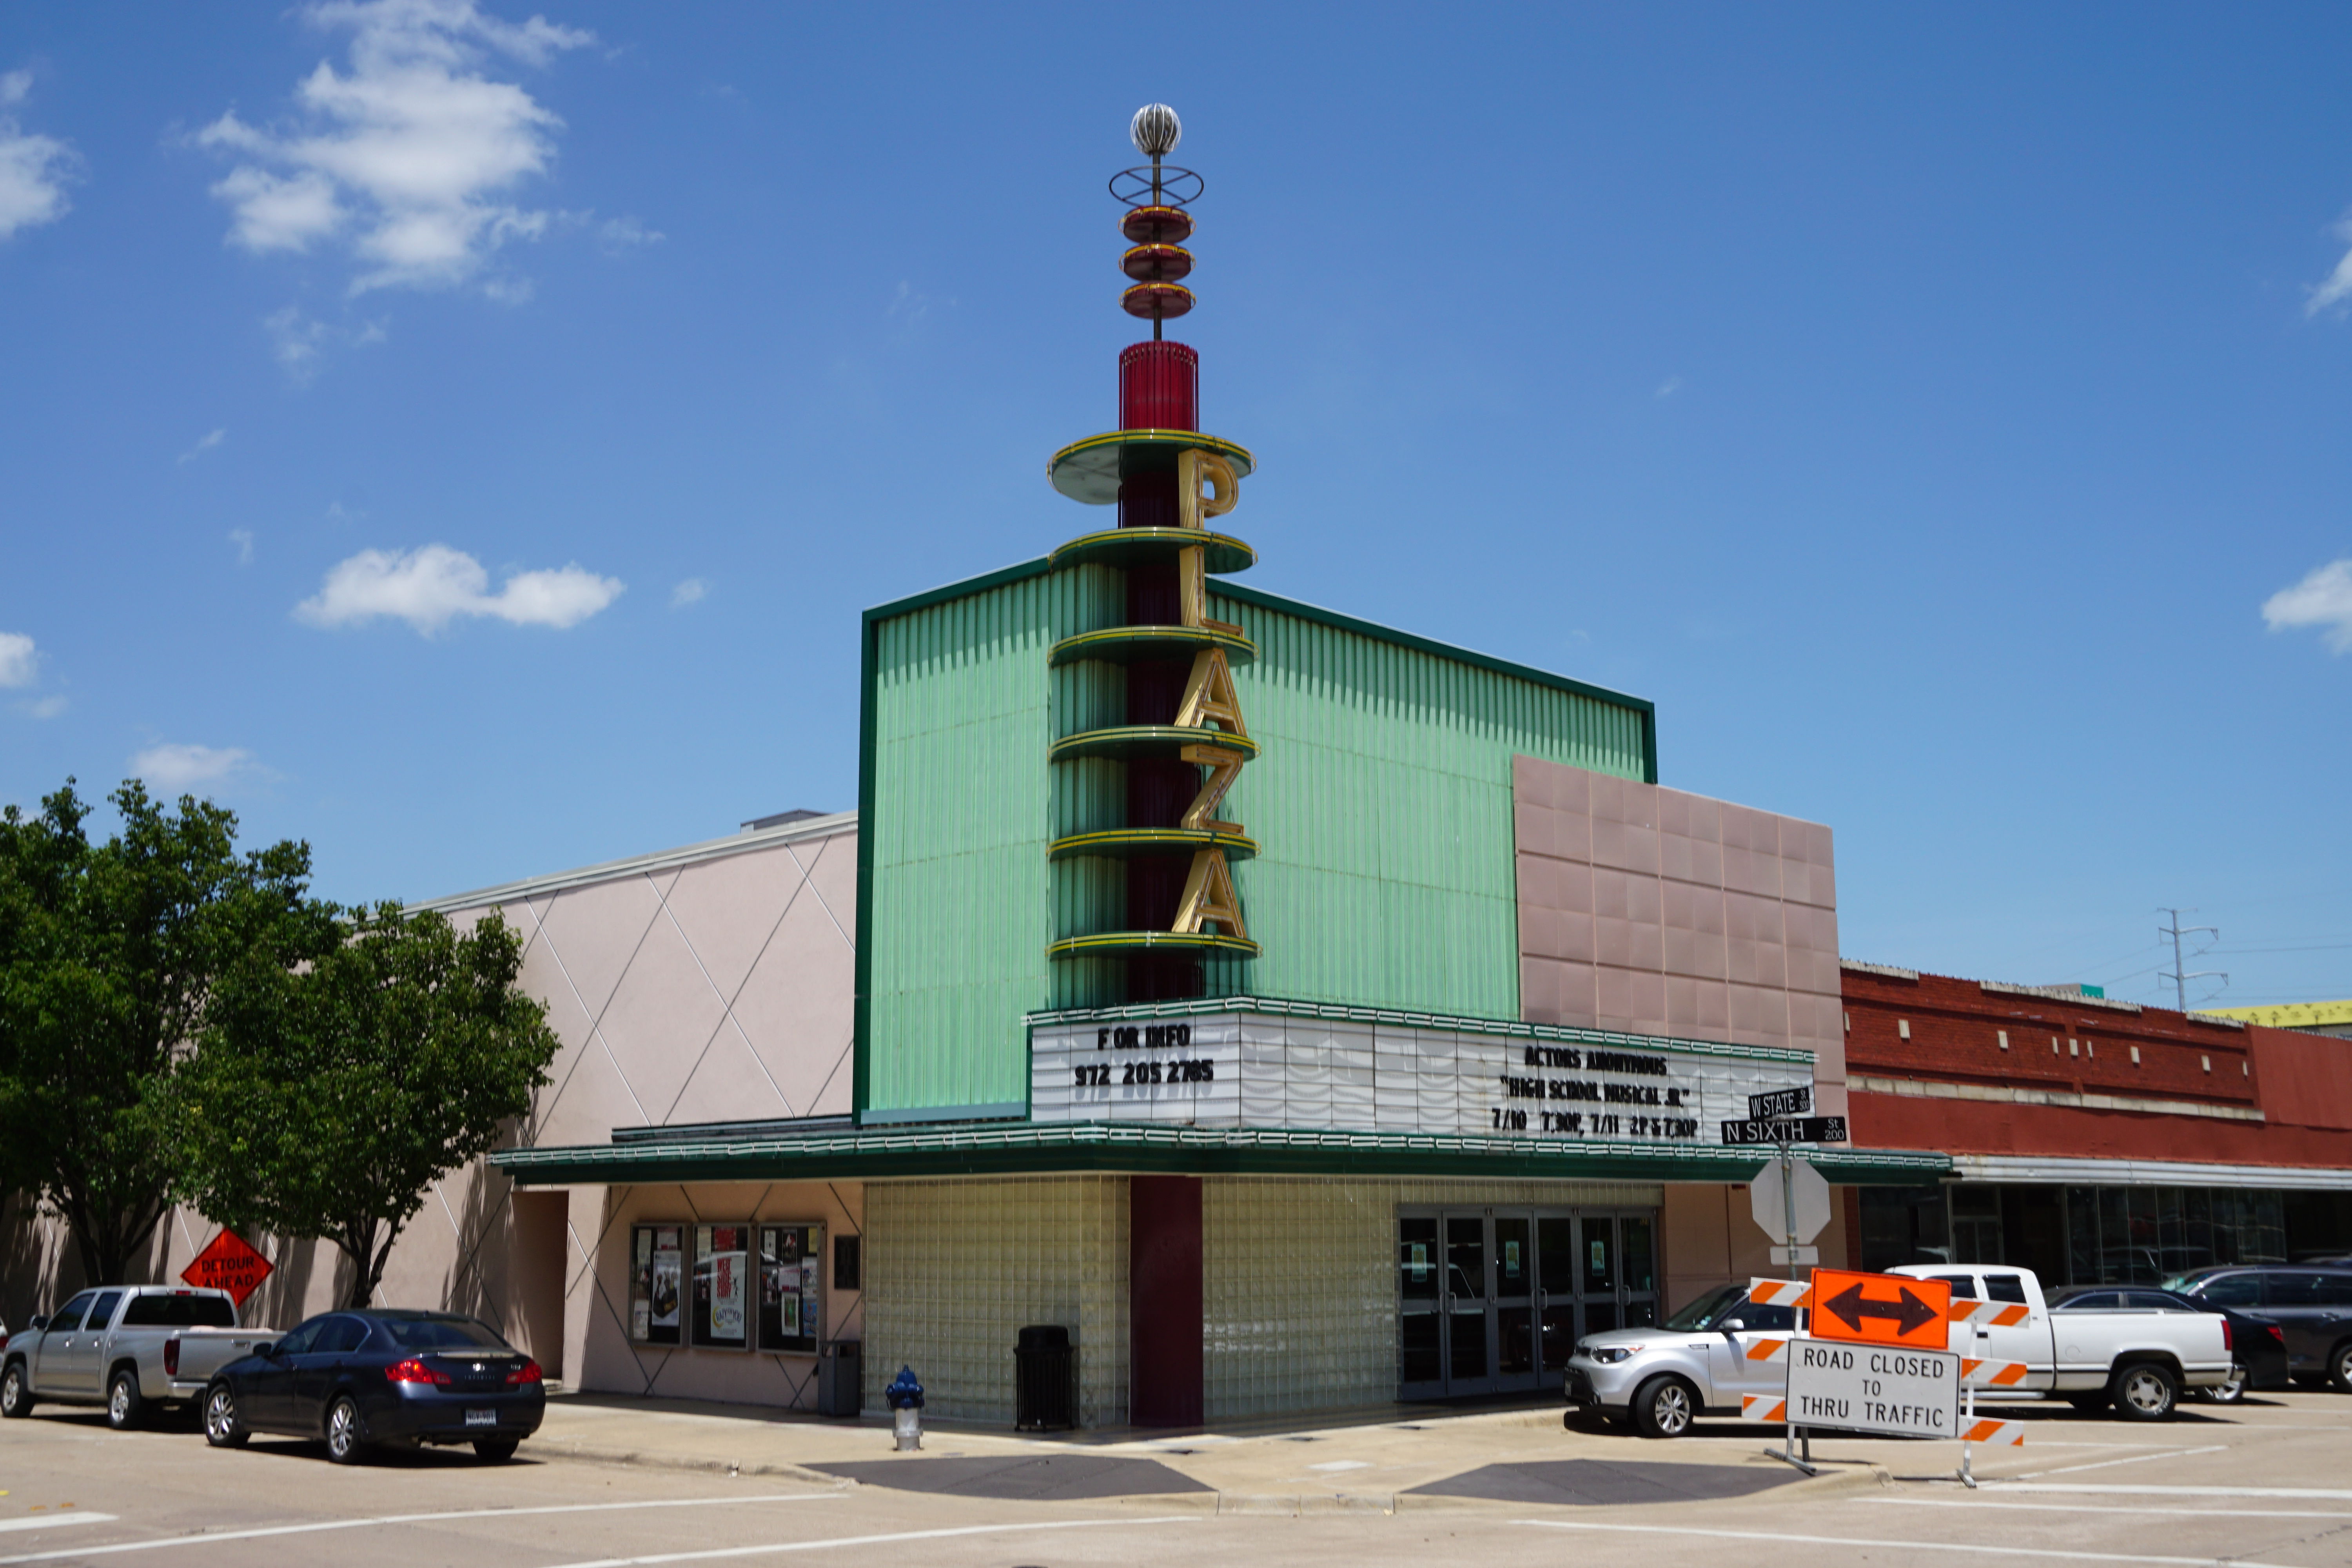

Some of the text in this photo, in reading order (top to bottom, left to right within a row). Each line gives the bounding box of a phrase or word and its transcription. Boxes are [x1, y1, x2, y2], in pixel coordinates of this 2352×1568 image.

[1172, 448, 1247, 939] PLAZA
[1098, 1024, 1191, 1050] FOR INFO
[1075, 1058, 1214, 1086] 972 205 2785
[1525, 1045, 1667, 1075] ACTORS ANONYMOUS
[1549, 1080, 1602, 1101] SCHOOL
[1604, 1083, 1662, 1105] MUSICAL
[1751, 1089, 1806, 1118] W STATE St
[1492, 1107, 1527, 1131] 7/10
[1590, 1112, 1619, 1134] 7/11
[1630, 1116, 1648, 1135] 2P
[1651, 1117, 1661, 1136] &
[1726, 1118, 1839, 1142] N SIXTH St
[1825, 1129, 1844, 1140] 200
[201, 1256, 254, 1273] DETOUR
[717, 1257, 732, 1272] WEST
[204, 1274, 254, 1289] AHEAD
[717, 1270, 731, 1285] SIDE
[717, 1283, 731, 1299] STORY
[1804, 1348, 1944, 1378] ROAD CLOSED
[1862, 1379, 1881, 1396] TO
[1801, 1396, 1944, 1427] THRU TRAFFIC
